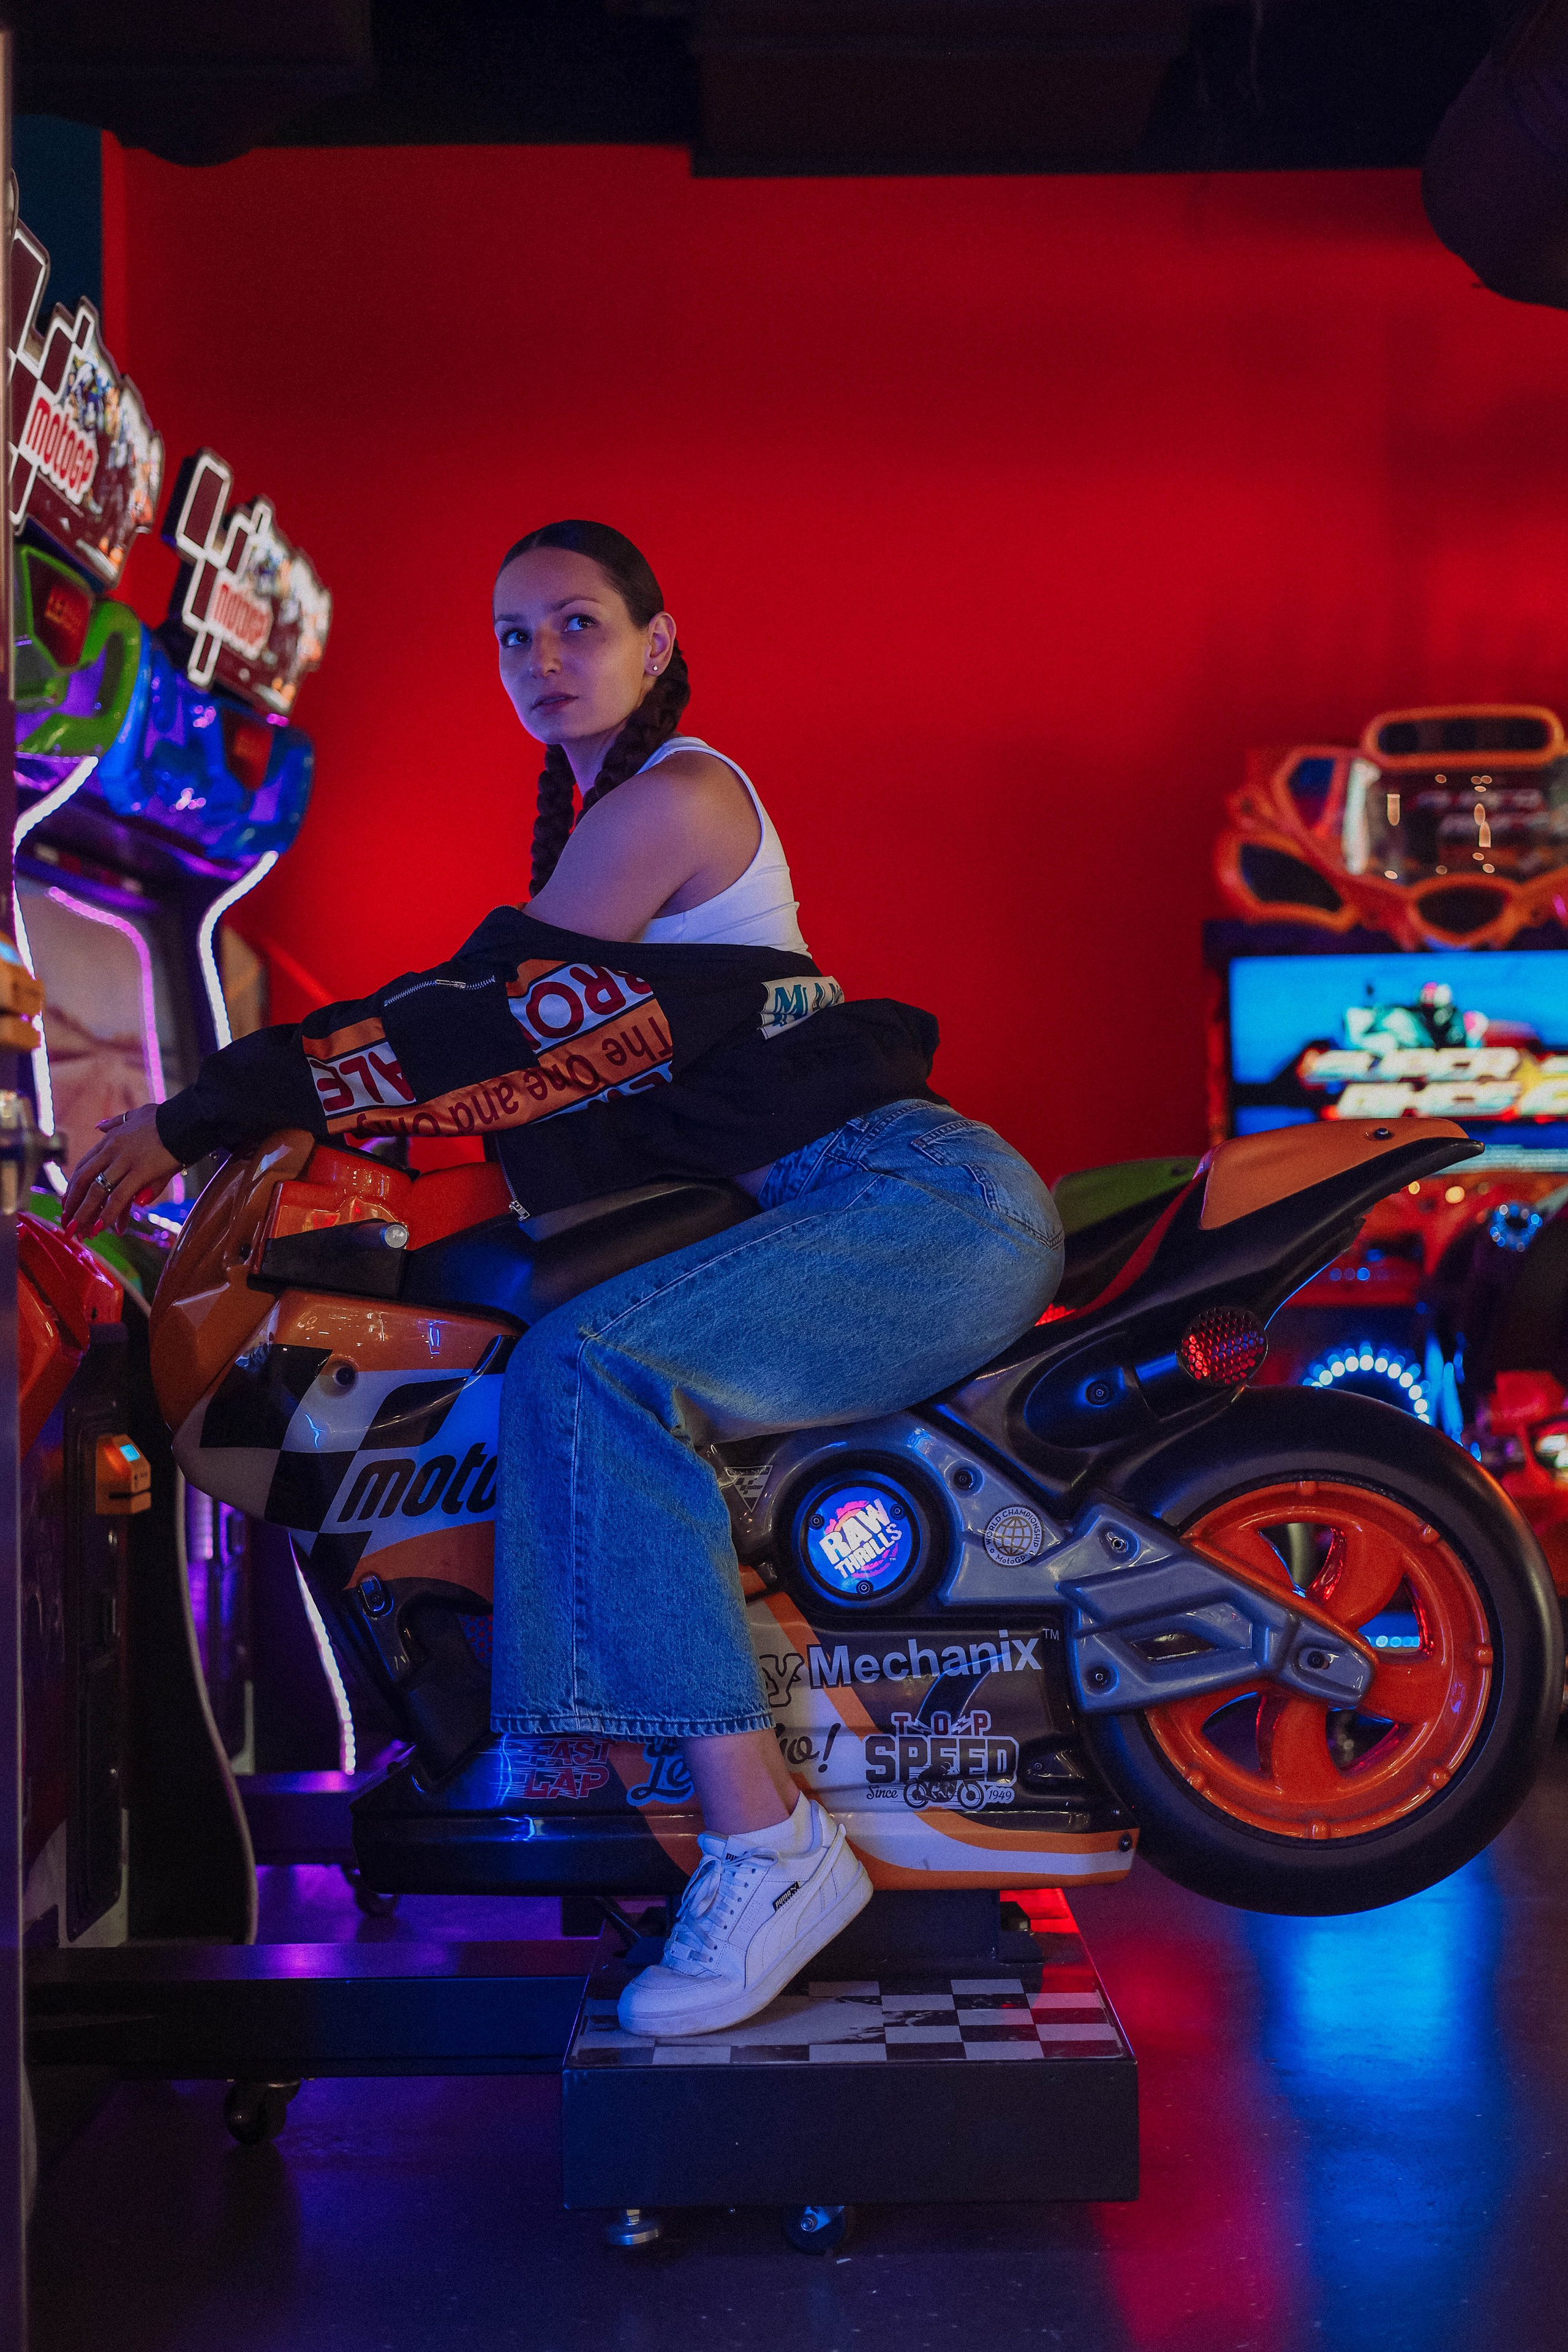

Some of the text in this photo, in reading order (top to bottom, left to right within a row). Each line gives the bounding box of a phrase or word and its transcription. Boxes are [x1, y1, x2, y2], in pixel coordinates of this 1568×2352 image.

[601, 1016, 673, 1066] The
[523, 1054, 600, 1101] One
[448, 1081, 519, 1135] and
[336, 1442, 497, 1523] moto
[819, 1498, 891, 1565] RAW
[834, 1523, 902, 1579] THRILLS
[986, 1509, 1041, 1548] WORLD CHAMPIONSHIP
[807, 1629, 1042, 1689] Mechanix
[522, 1765, 609, 1799] LAP
[865, 1736, 1017, 1784] SPEED
[866, 1784, 1012, 1801] Since 1949
